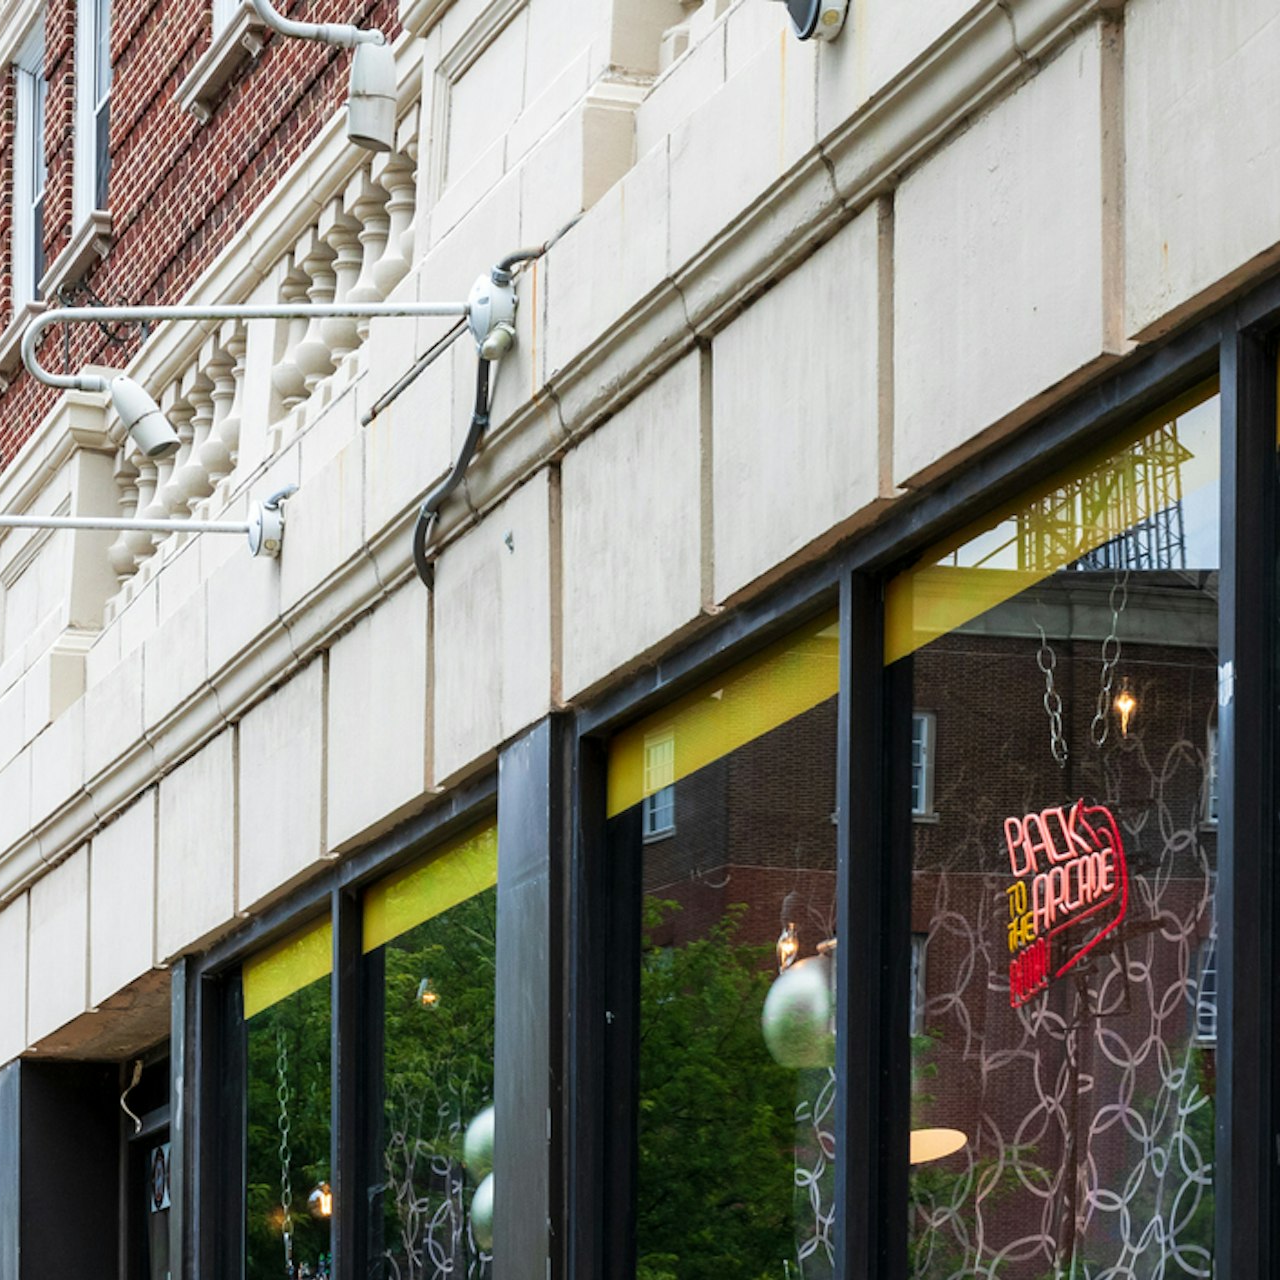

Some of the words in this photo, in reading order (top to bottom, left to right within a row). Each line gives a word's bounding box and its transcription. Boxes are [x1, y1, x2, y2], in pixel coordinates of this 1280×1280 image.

[1004, 804, 1093, 877] BACK
[1006, 880, 1027, 919] TO
[1032, 847, 1115, 936] ARCADE
[1007, 910, 1036, 953] THE
